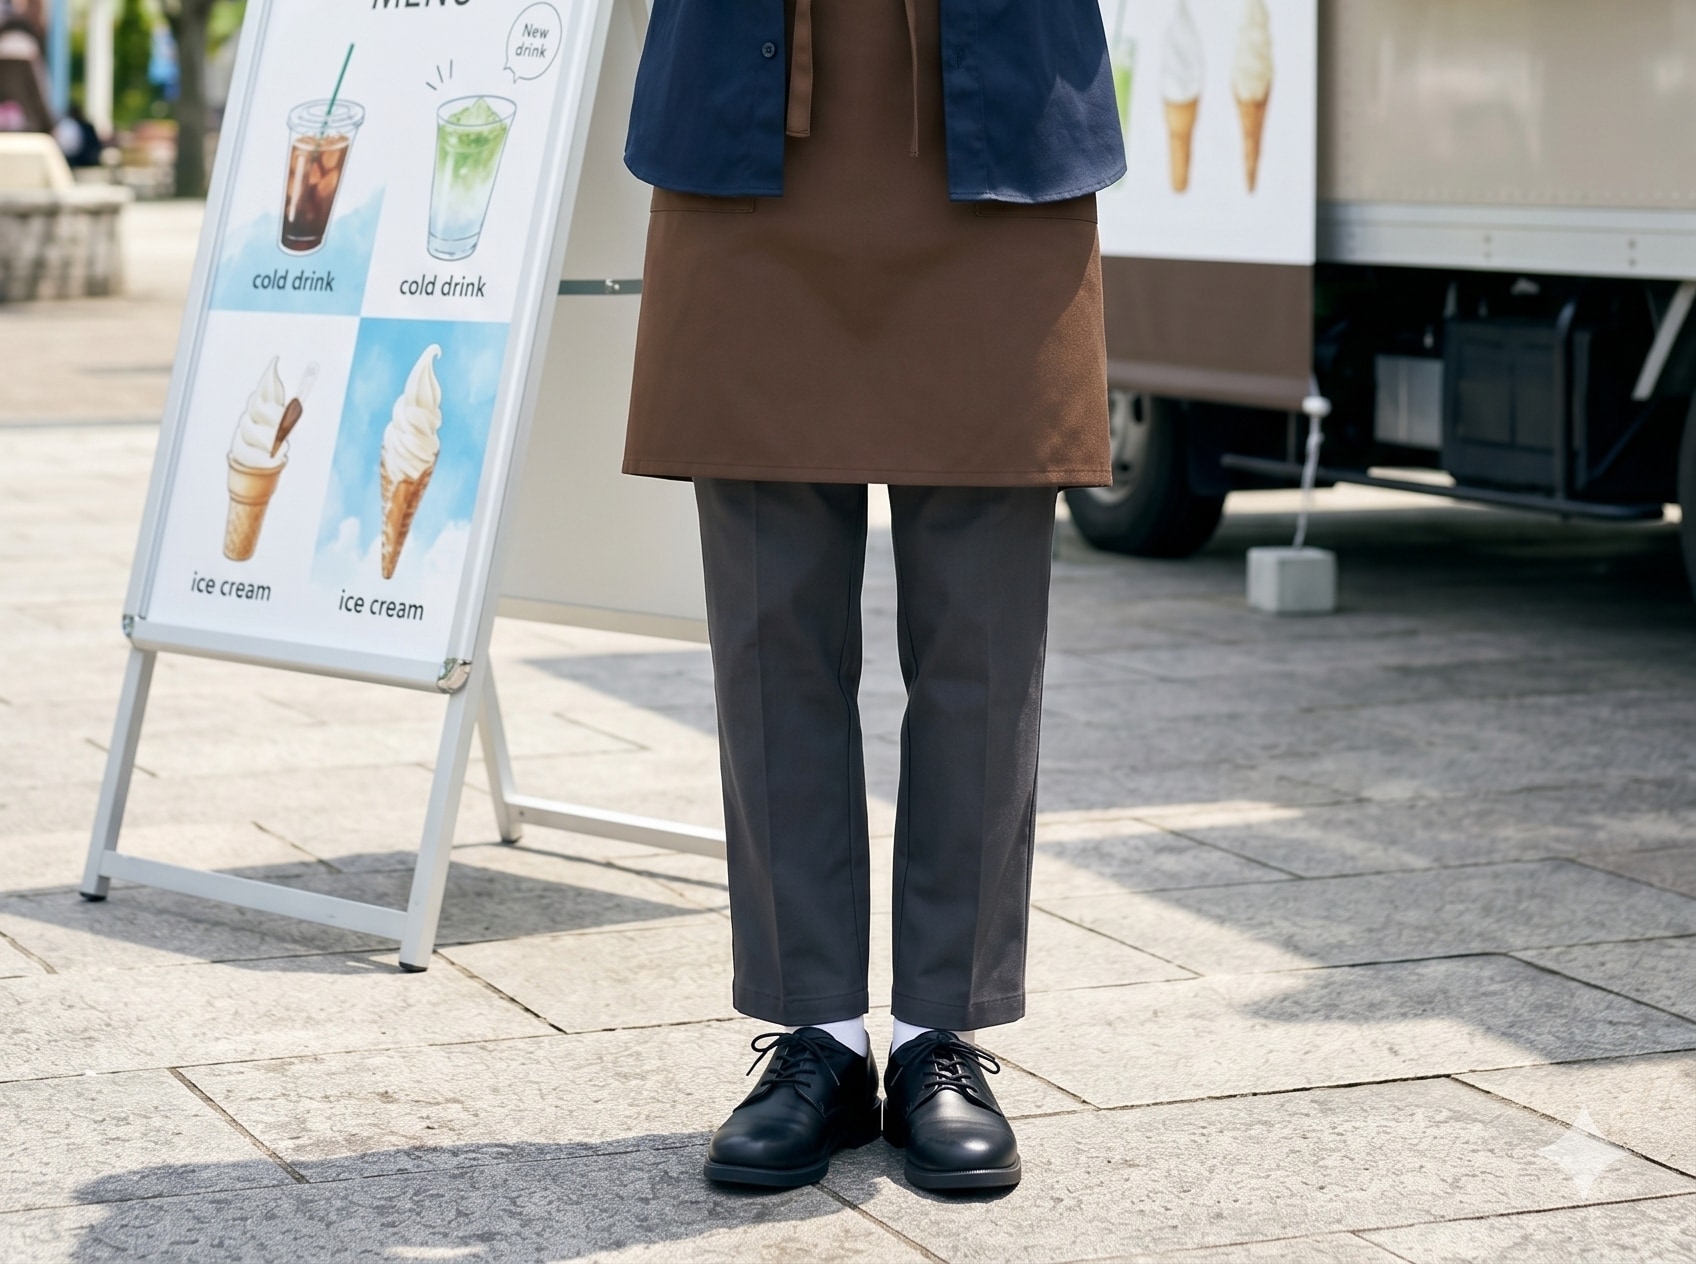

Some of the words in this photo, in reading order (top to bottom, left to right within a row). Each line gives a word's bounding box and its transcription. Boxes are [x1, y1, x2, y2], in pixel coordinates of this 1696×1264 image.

[522, 22, 550, 40] New
[514, 42, 547, 59] drink
[252, 269, 288, 291] cold
[291, 269, 335, 293] drink
[399, 274, 437, 297] cold
[440, 274, 487, 299] drink
[190, 570, 216, 595] ice
[219, 580, 272, 602] cream
[338, 588, 366, 615] ice
[369, 598, 425, 622] cream
